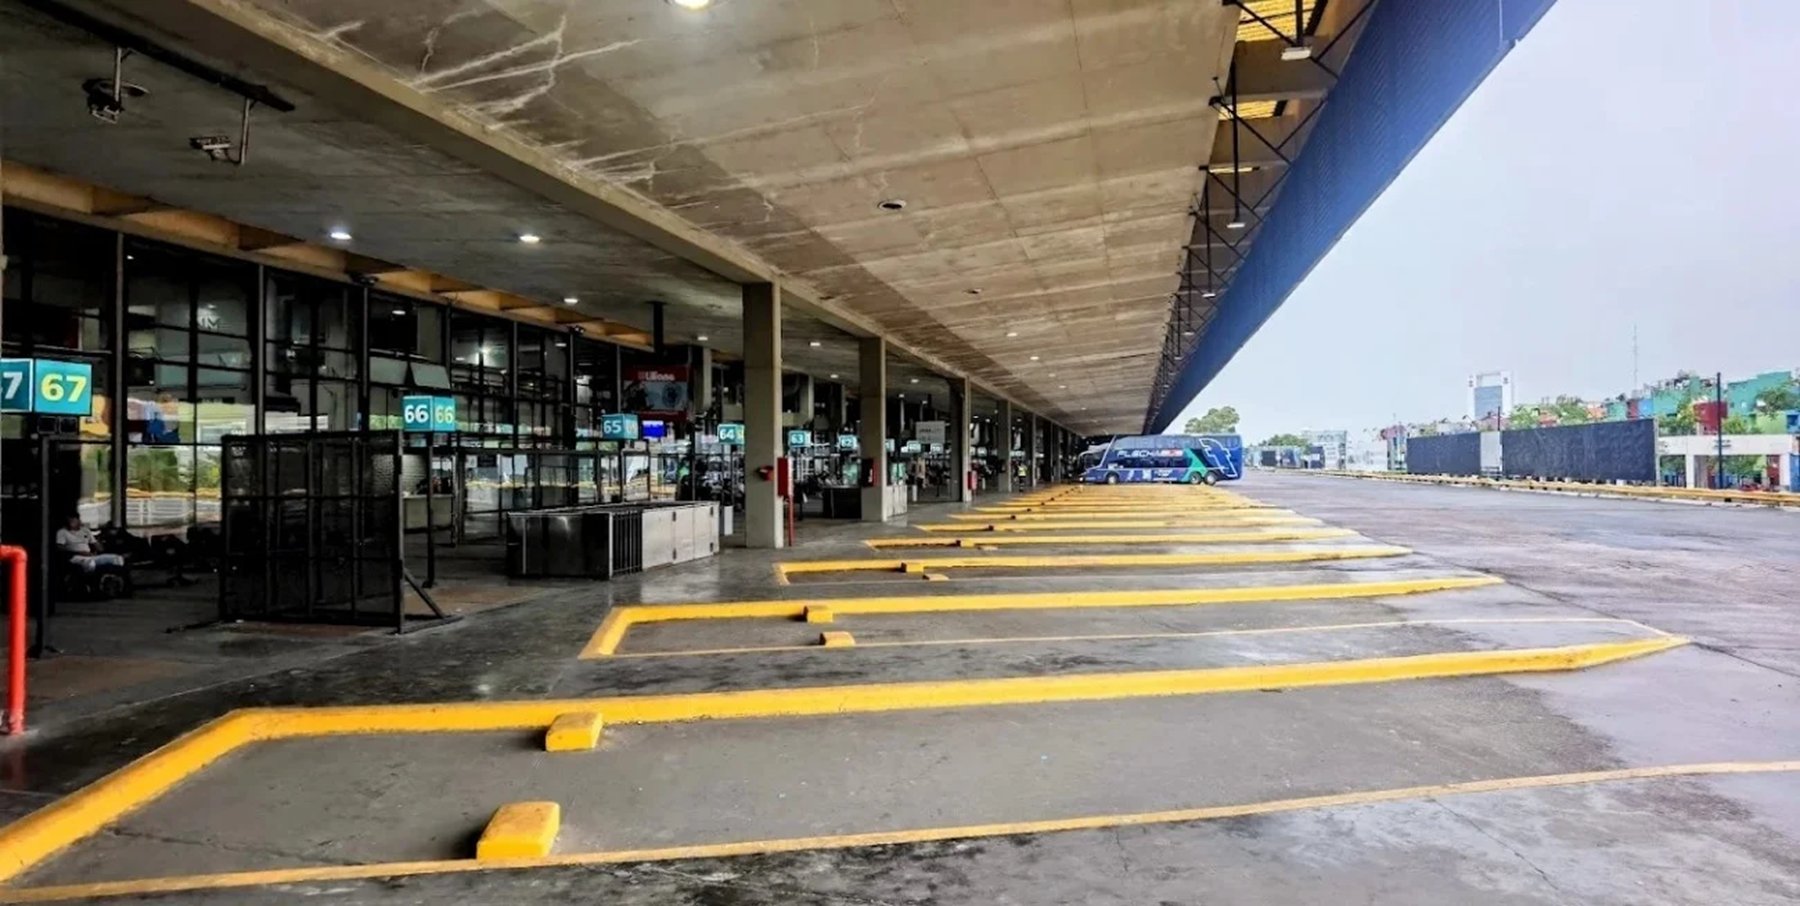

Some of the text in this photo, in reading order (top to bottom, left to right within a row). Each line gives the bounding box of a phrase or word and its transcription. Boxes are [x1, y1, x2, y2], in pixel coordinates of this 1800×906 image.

[1, 371, 23, 399] 7
[41, 373, 87, 402] 67
[405, 404, 429, 423] 66
[435, 405, 454, 424] 66
[603, 420, 621, 434] 65
[719, 428, 735, 440] 64
